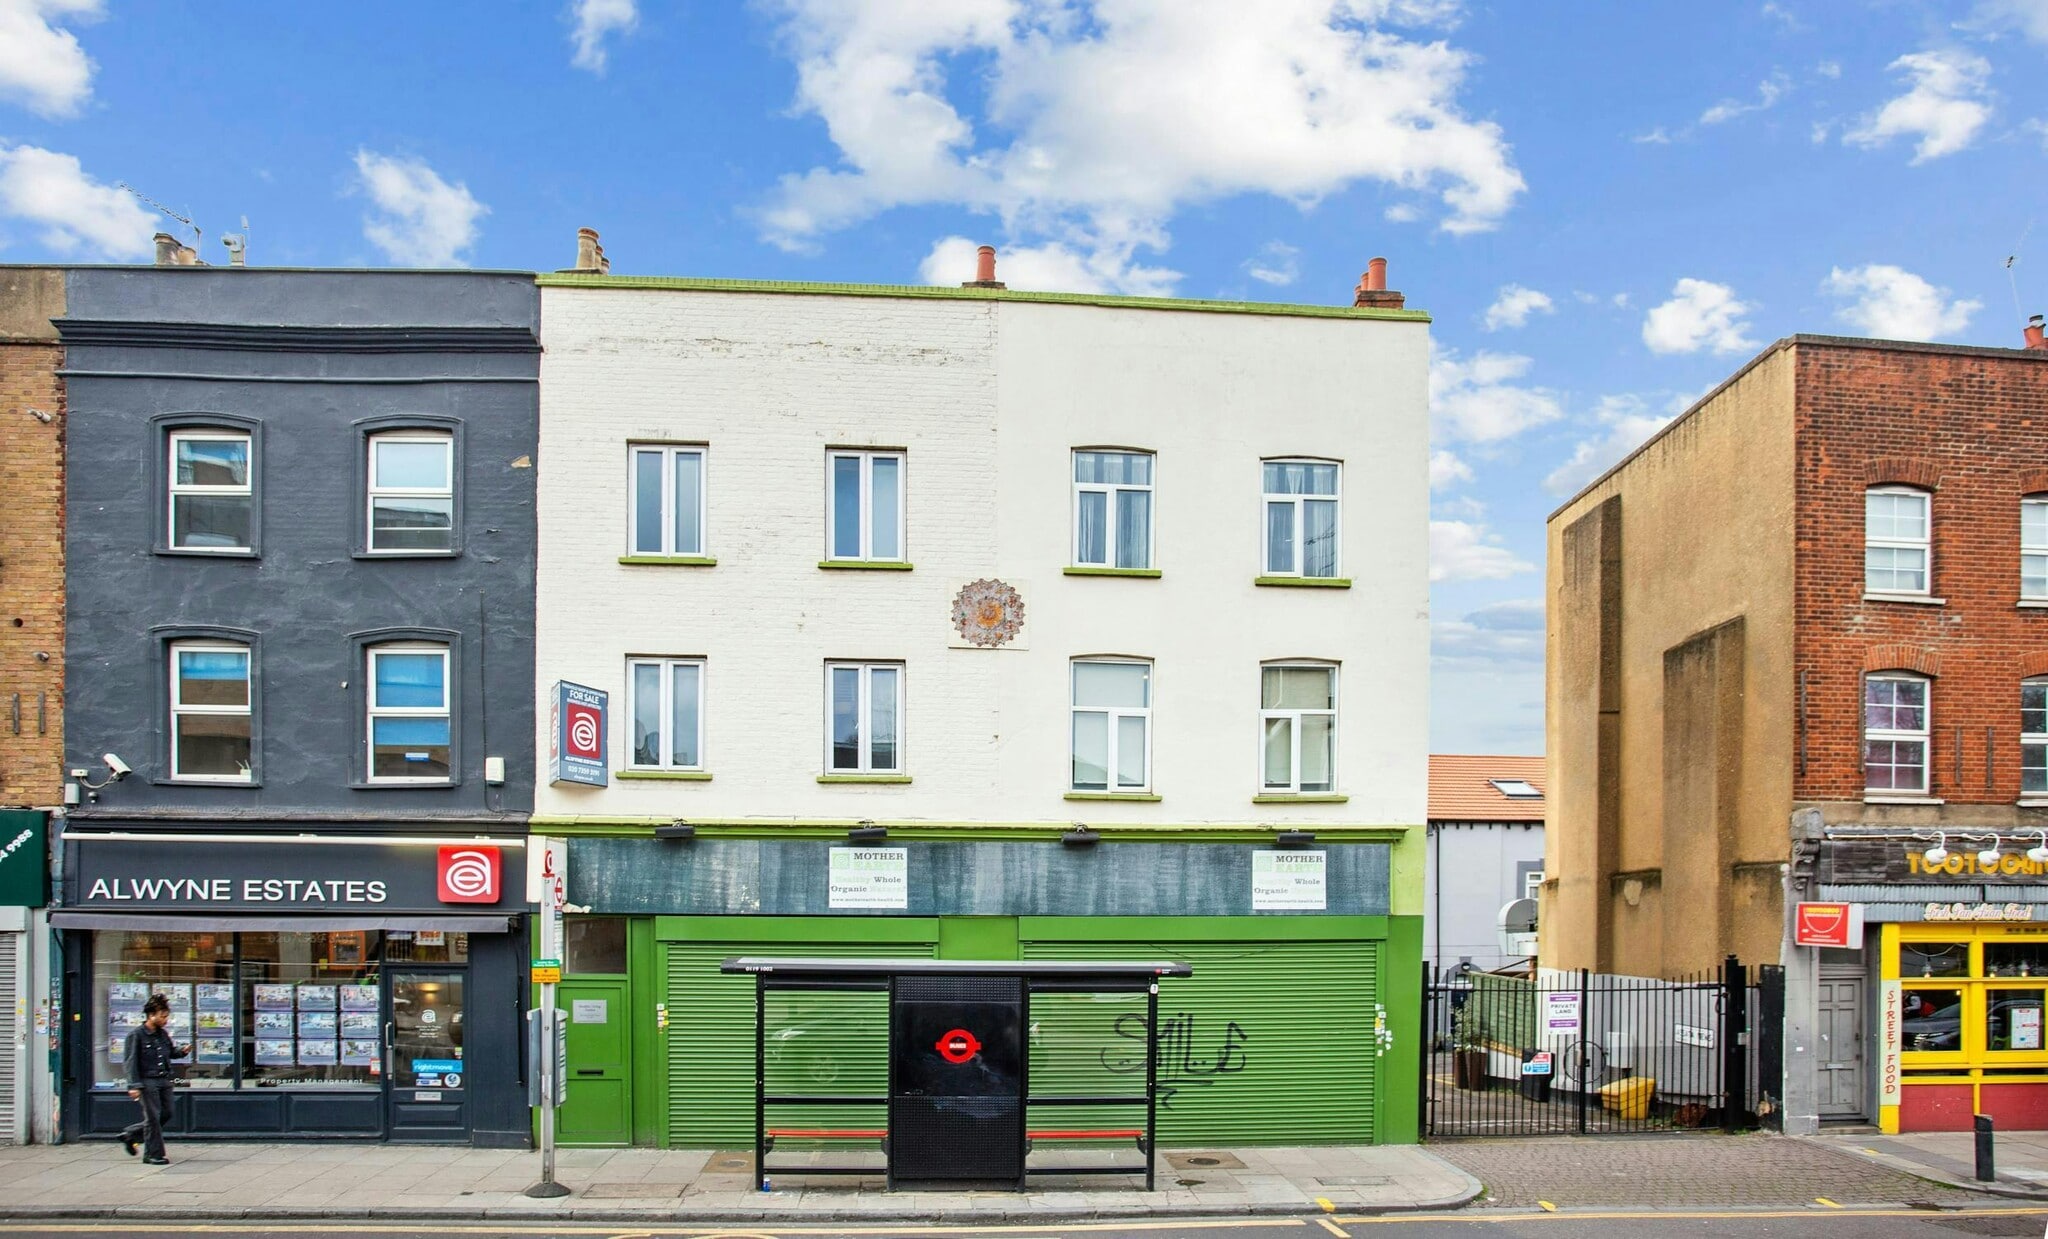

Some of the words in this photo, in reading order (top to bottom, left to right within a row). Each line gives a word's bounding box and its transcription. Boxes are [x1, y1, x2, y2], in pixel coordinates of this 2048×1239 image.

[569, 689, 584, 701] FOR
[584, 694, 600, 705] SALE
[853, 852, 905, 860] MOTHER
[1275, 855, 1323, 863] MOTHER
[88, 878, 231, 901] ALWYNE
[243, 880, 387, 903] ESTATES
[831, 885, 867, 893] Organic
[1254, 887, 1288, 895] Organic
[1886, 990, 1896, 1050] STREET
[413, 1063, 454, 1072] rightmove
[1885, 1055, 1896, 1094] FOOD
[260, 1077, 301, 1085] Property
[304, 1077, 363, 1085] Management
